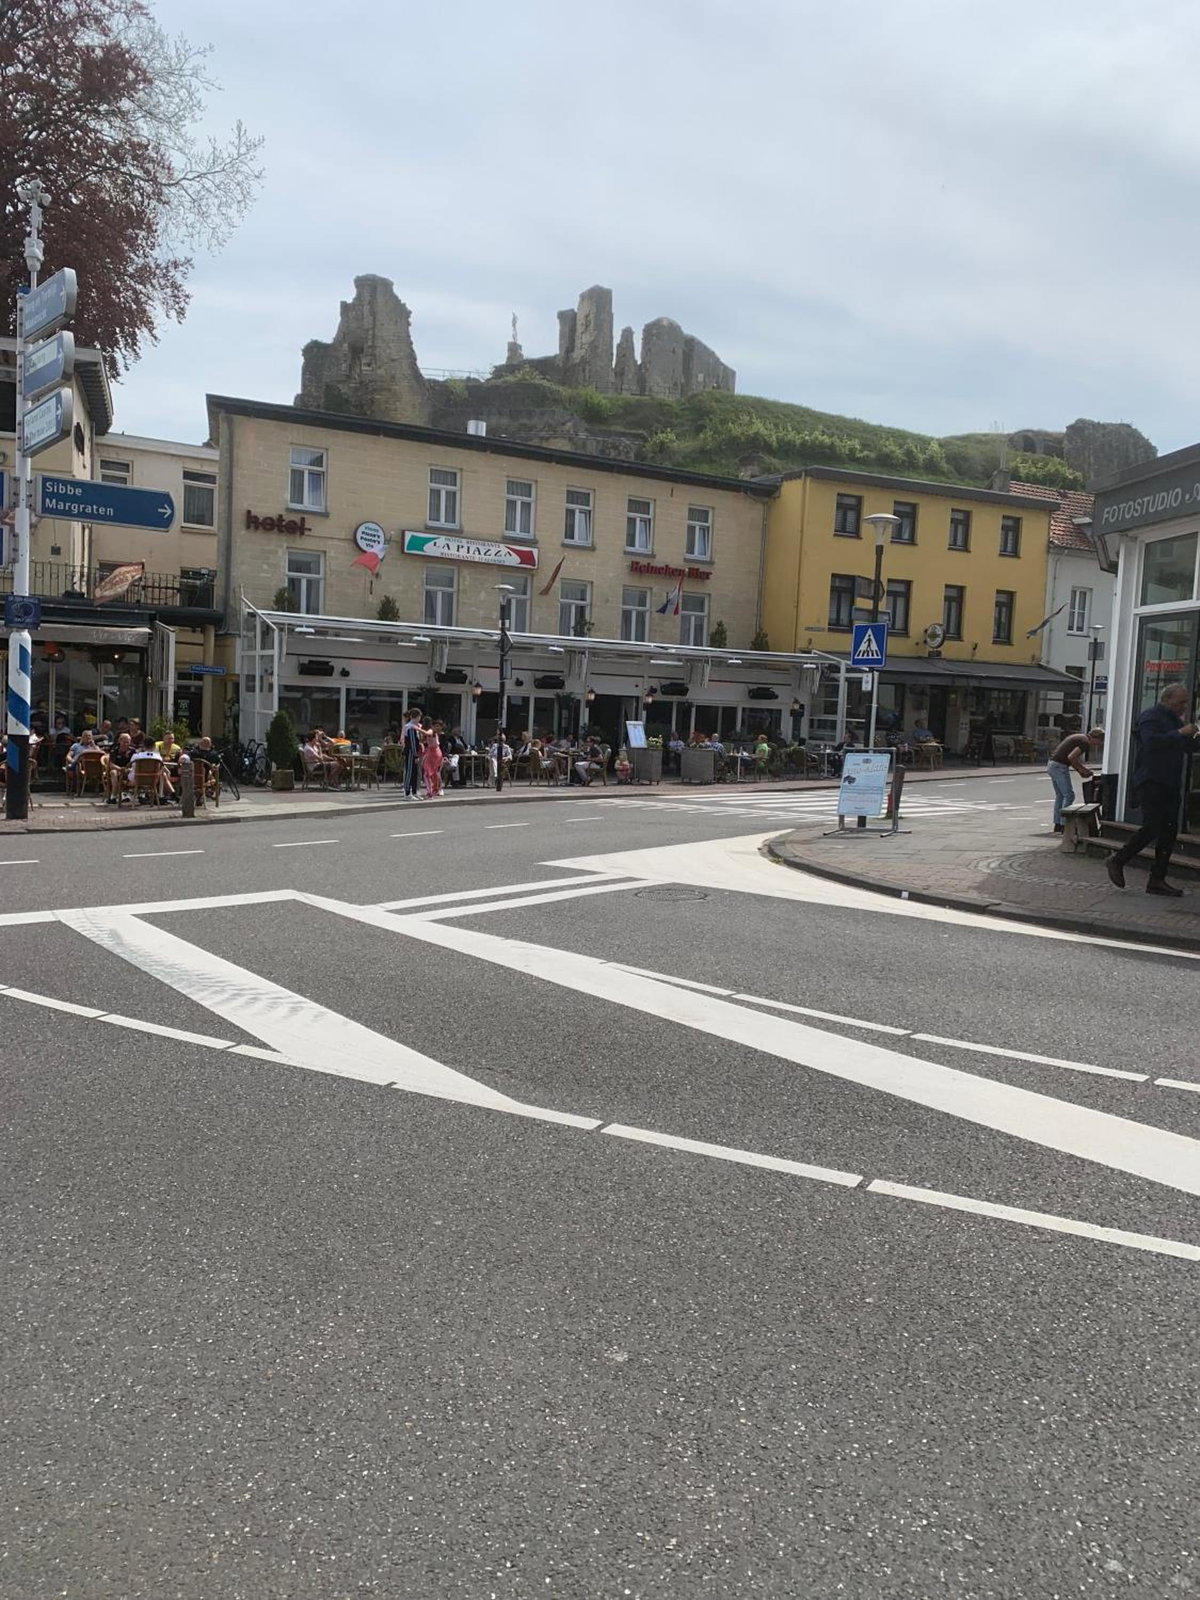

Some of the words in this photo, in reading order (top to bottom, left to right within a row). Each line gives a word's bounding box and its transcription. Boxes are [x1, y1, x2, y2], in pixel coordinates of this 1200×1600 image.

[45, 481, 83, 496] Sibbe
[45, 498, 114, 516] Margraten
[1102, 487, 1182, 525] FOTOSTUDIO
[246, 510, 306, 536] hotel
[433, 541, 451, 551] LA
[456, 543, 513, 558] PIAZZA
[630, 560, 685, 577] Heineken
